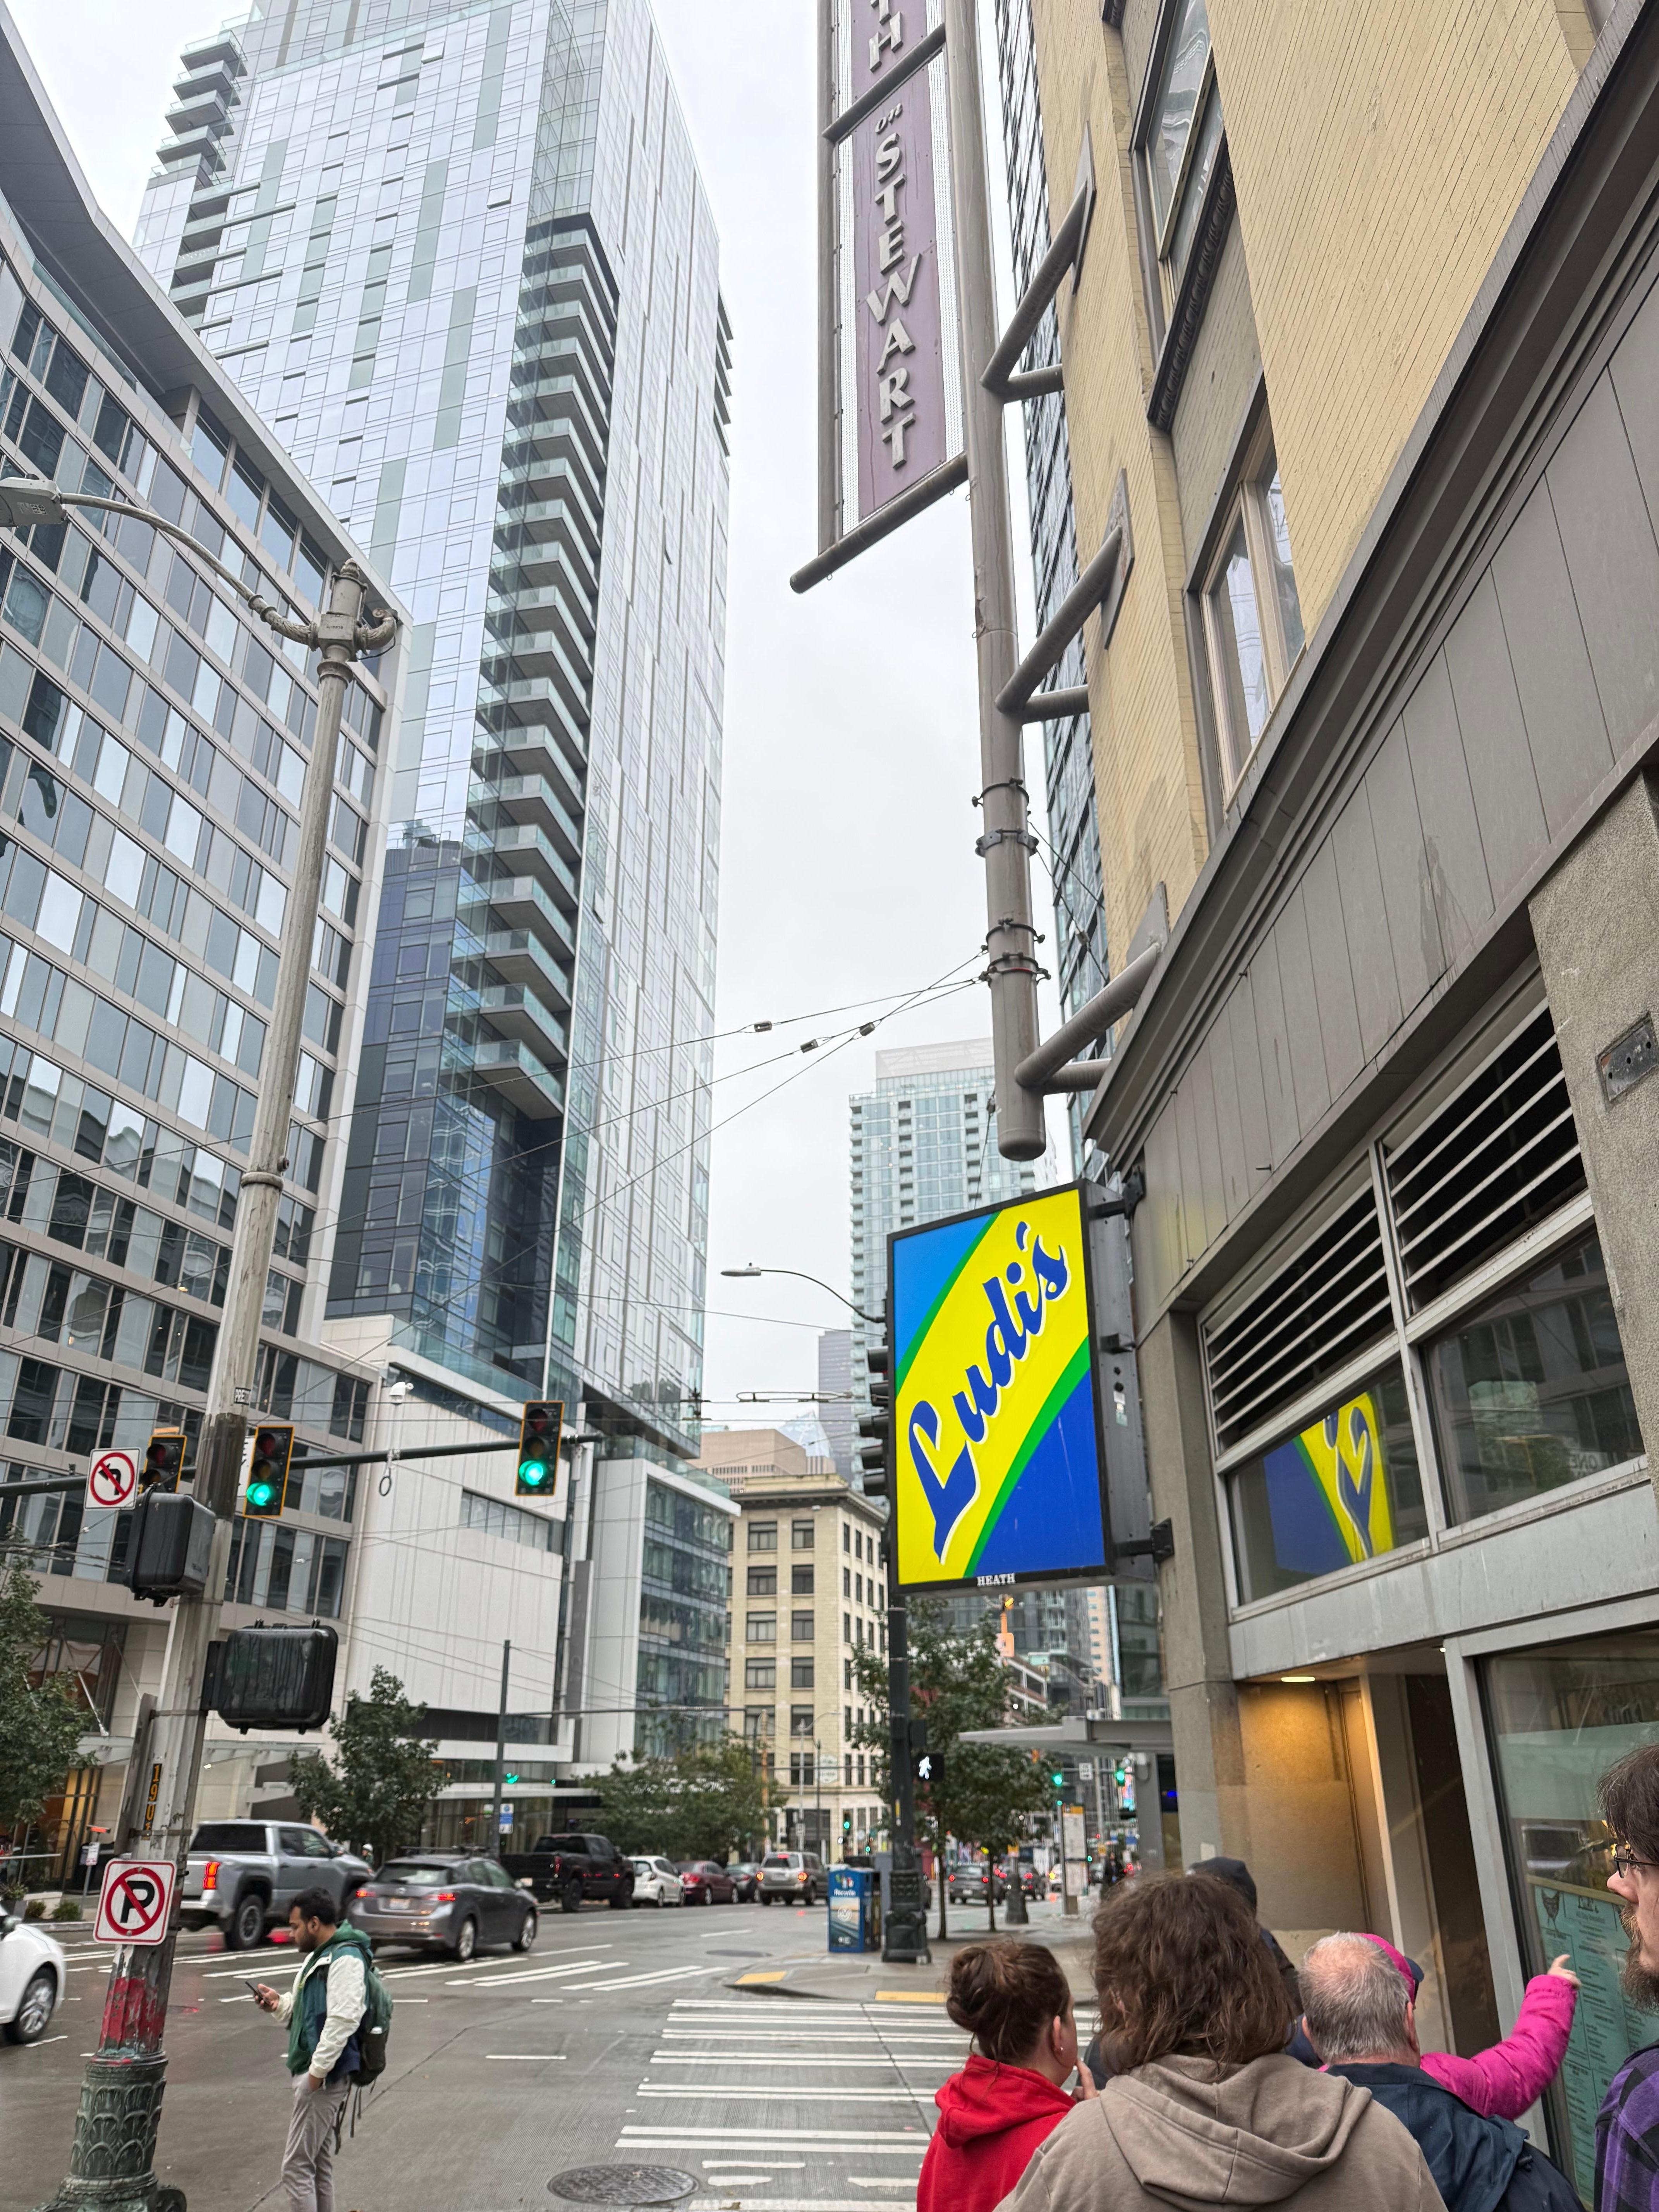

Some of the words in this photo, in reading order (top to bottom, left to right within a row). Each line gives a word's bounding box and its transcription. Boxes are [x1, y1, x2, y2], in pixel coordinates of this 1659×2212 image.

[875, 103, 903, 135] on
[865, 132, 922, 470] STEWART
[38, 505, 47, 514] LED
[909, 1221, 1071, 1565] Ludi's
[976, 1573, 1016, 1587] HEATH
[120, 1881, 155, 1923] P
